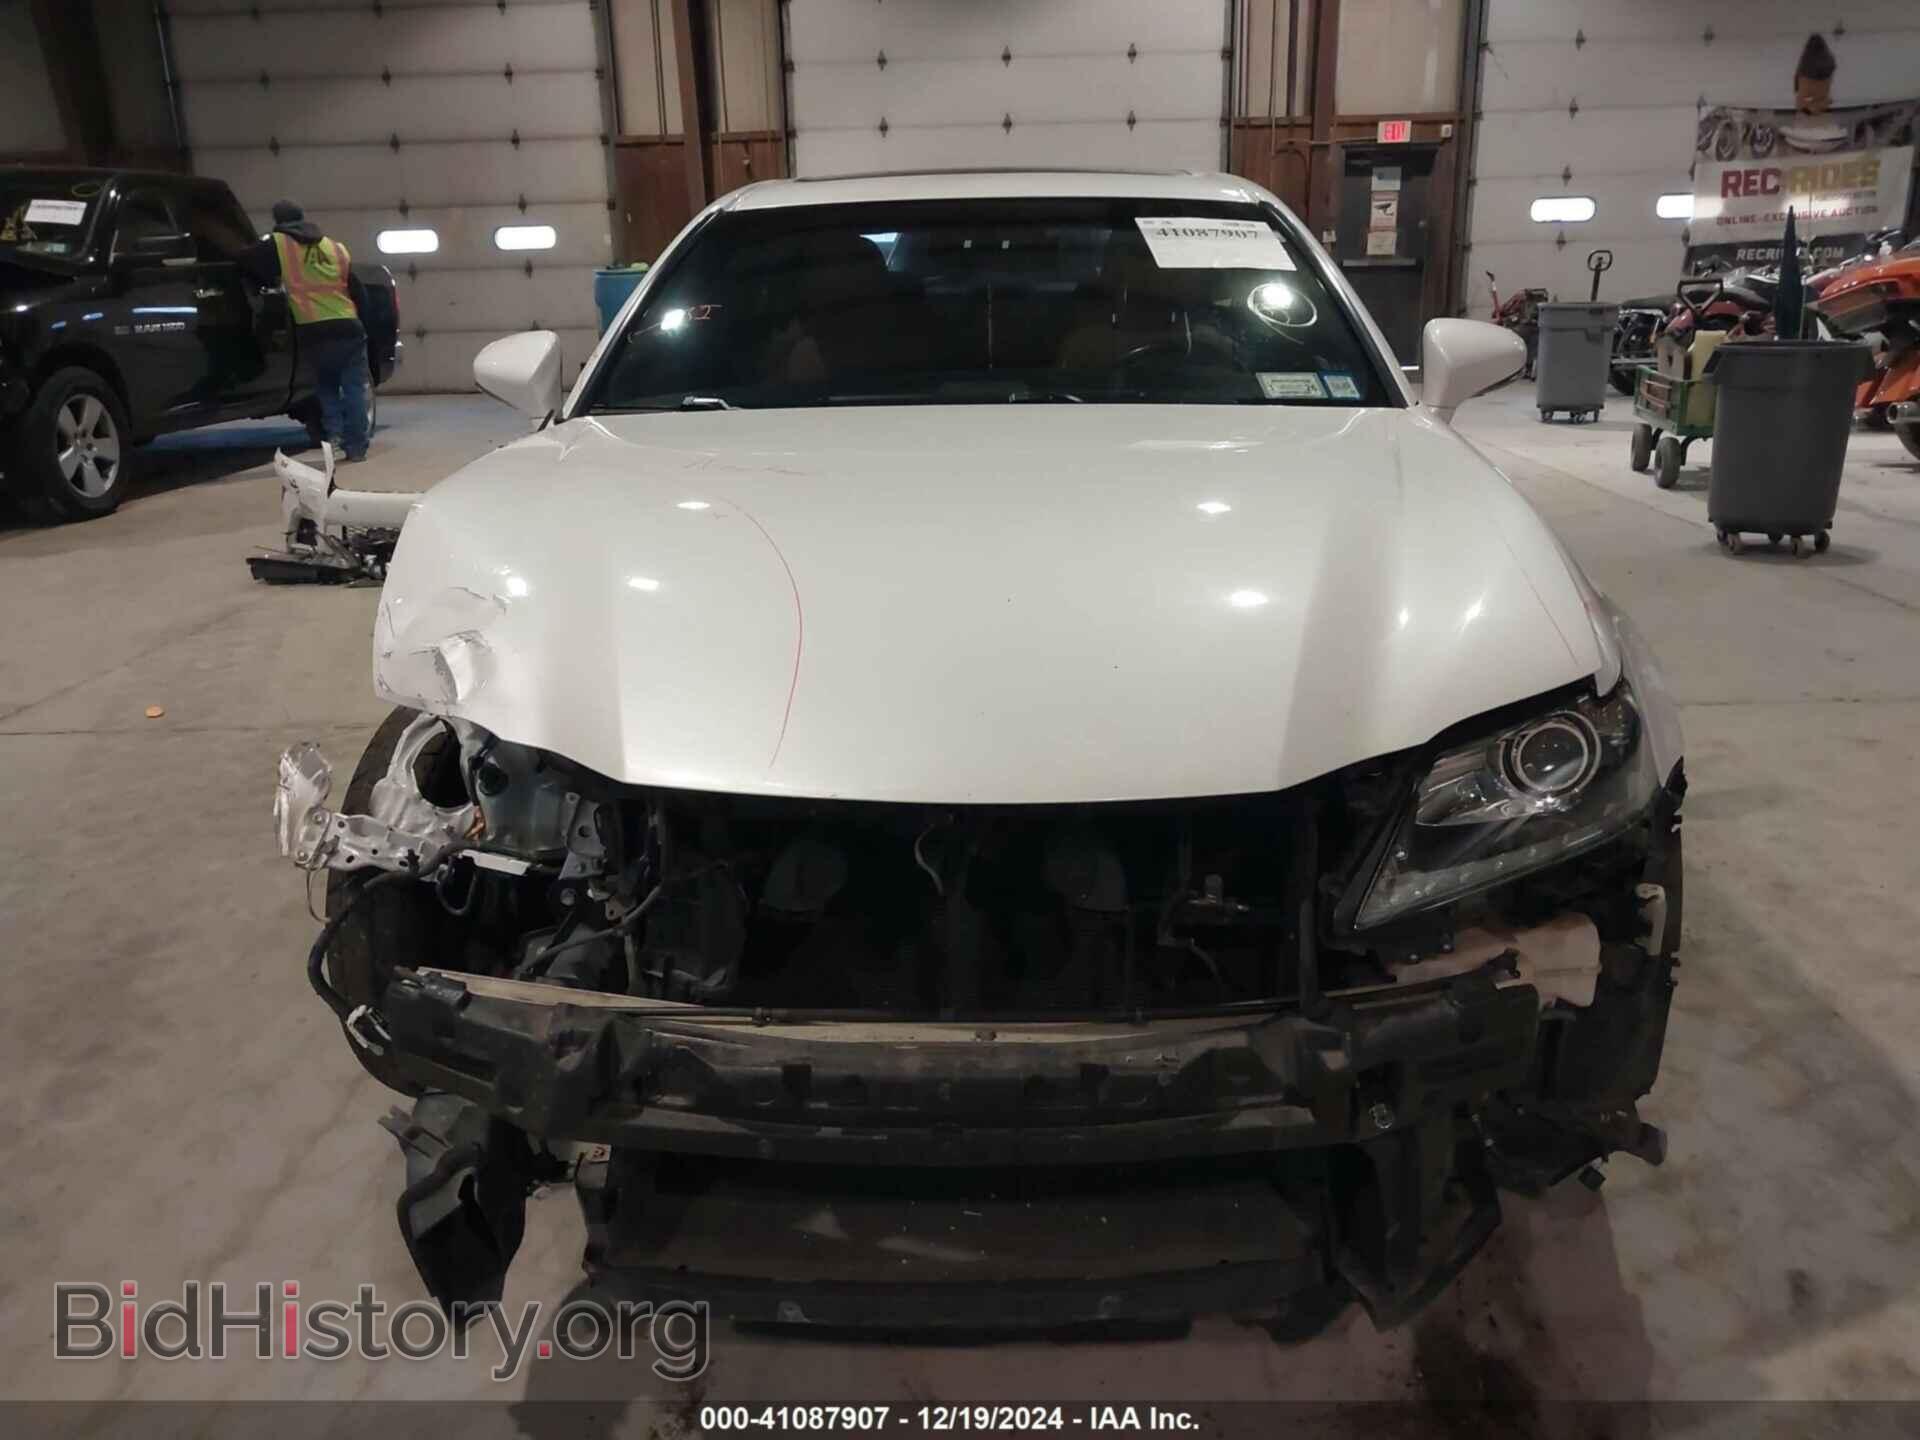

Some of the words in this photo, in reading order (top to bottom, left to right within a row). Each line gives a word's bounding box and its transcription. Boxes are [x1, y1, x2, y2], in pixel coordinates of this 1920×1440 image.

[1720, 168, 1781, 198] REC
[1790, 161, 1880, 193] RIDES
[1831, 205, 1878, 219] AUCTION
